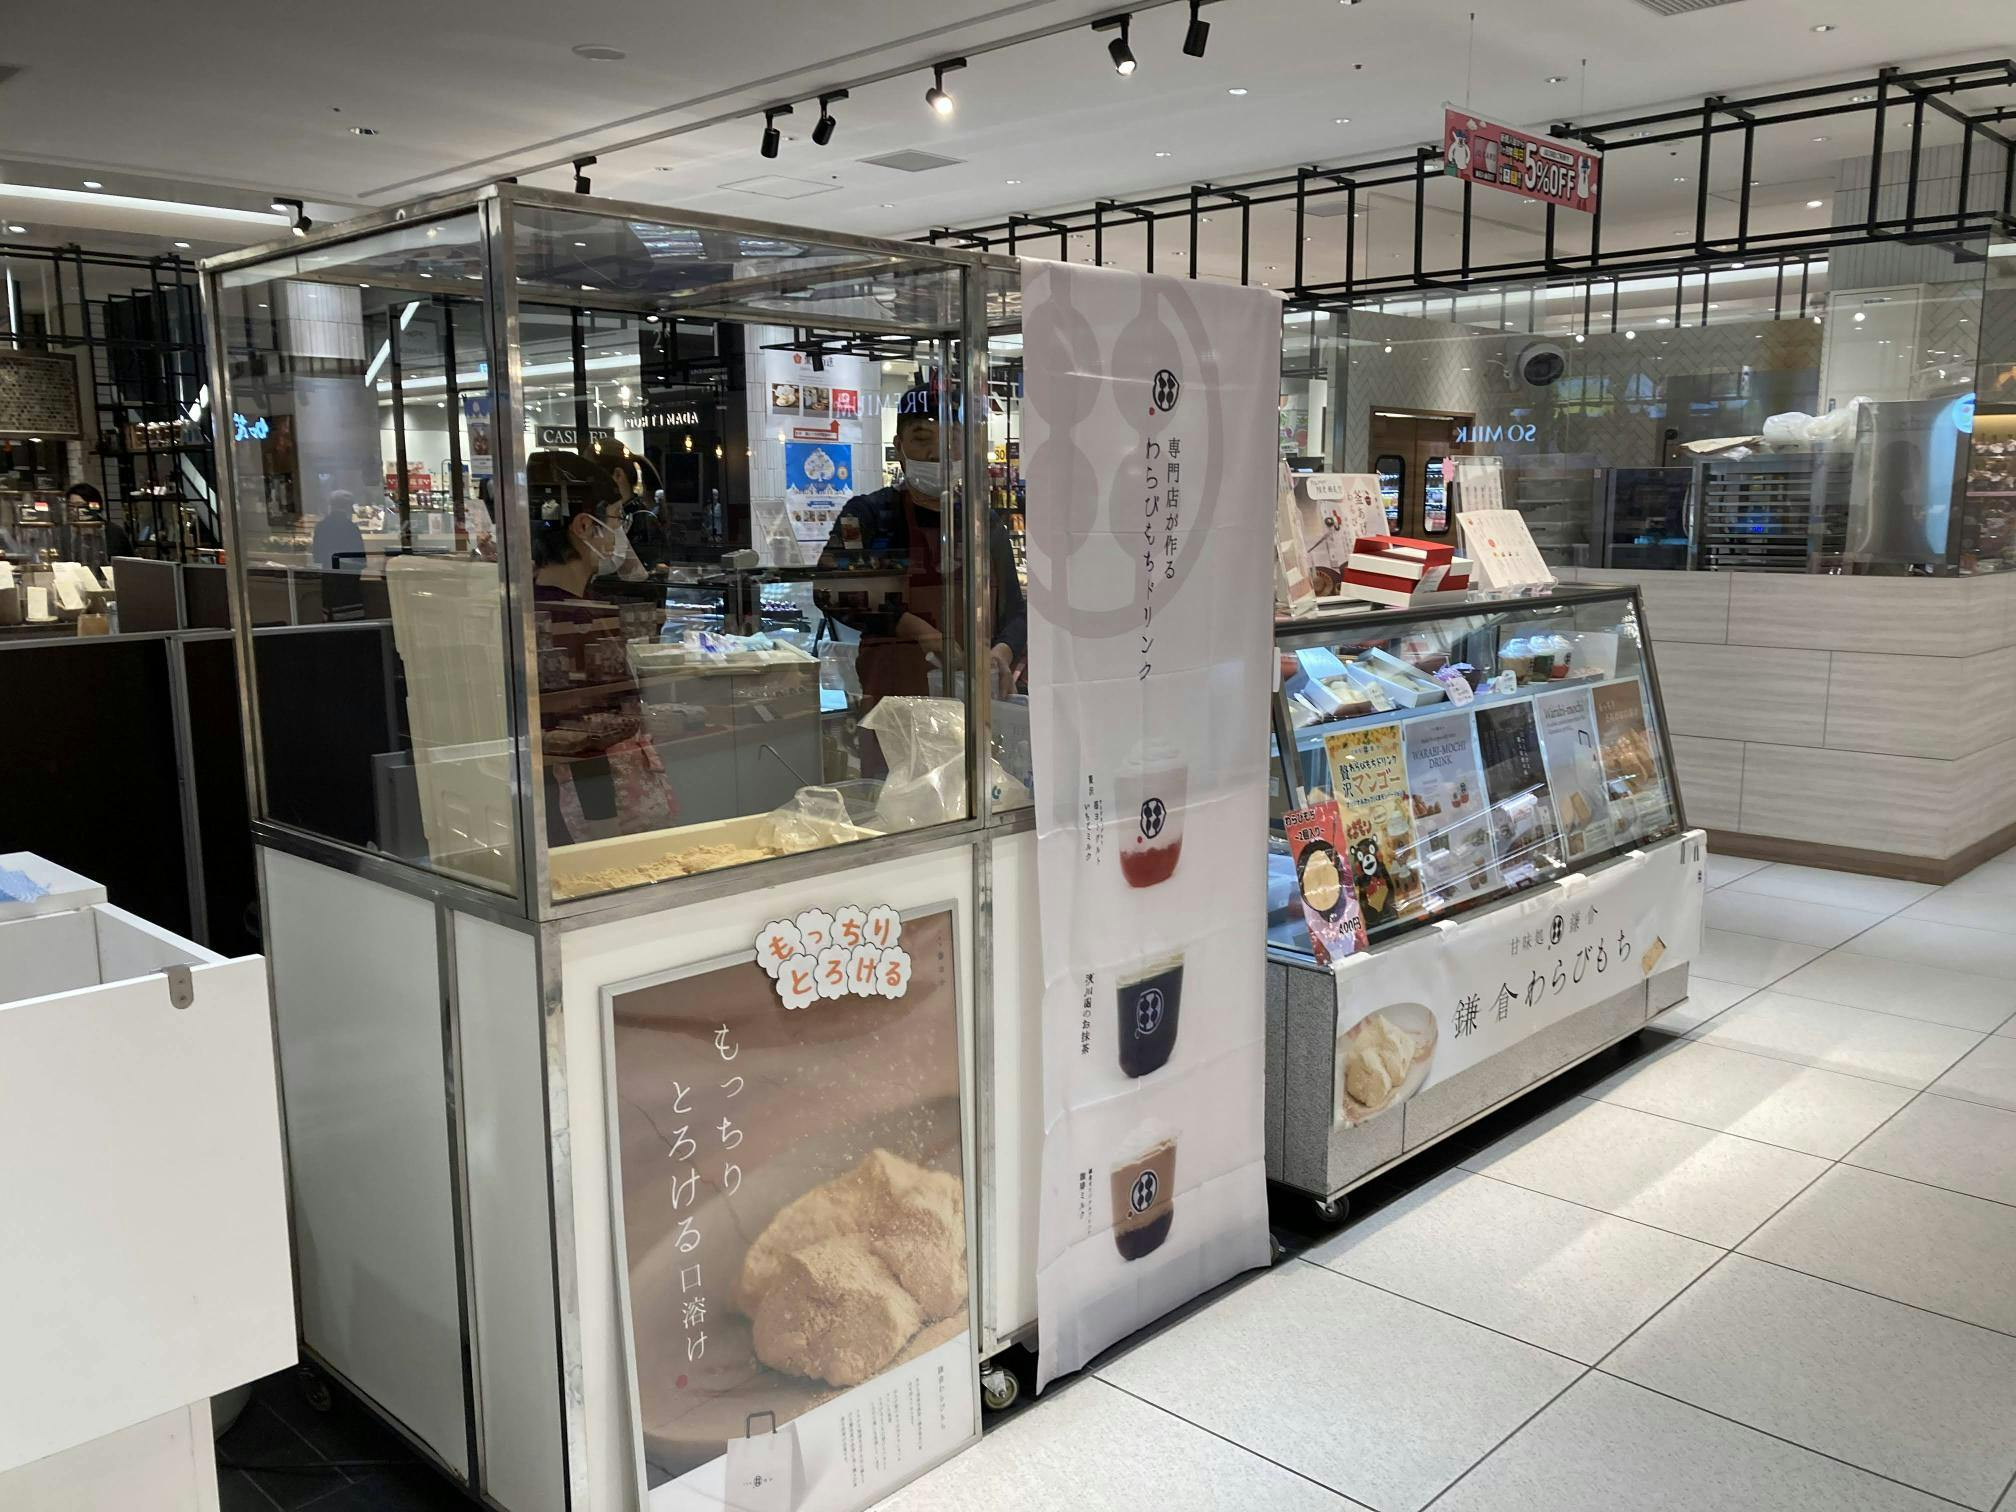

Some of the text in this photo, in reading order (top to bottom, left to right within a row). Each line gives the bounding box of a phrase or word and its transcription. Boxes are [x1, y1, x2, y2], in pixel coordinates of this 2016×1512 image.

[1524, 142, 1576, 200] 5%OFF
[543, 429, 608, 444] CASER
[1164, 436, 1182, 580] 専門店が作る
[1137, 438, 1161, 682] わらびもちドリンク
[1411, 741, 1467, 761] WARABI-MOCHI
[1429, 755, 1453, 769] DRINK
[1351, 768, 1401, 795] マンゴー
[769, 917, 890, 960] もっちり
[791, 956, 901, 995] とろける
[1451, 929, 1632, 1040] 鎌倉わらびもち
[714, 1023, 744, 1197] もっちり
[668, 1080, 708, 1363] とろける口溶け
